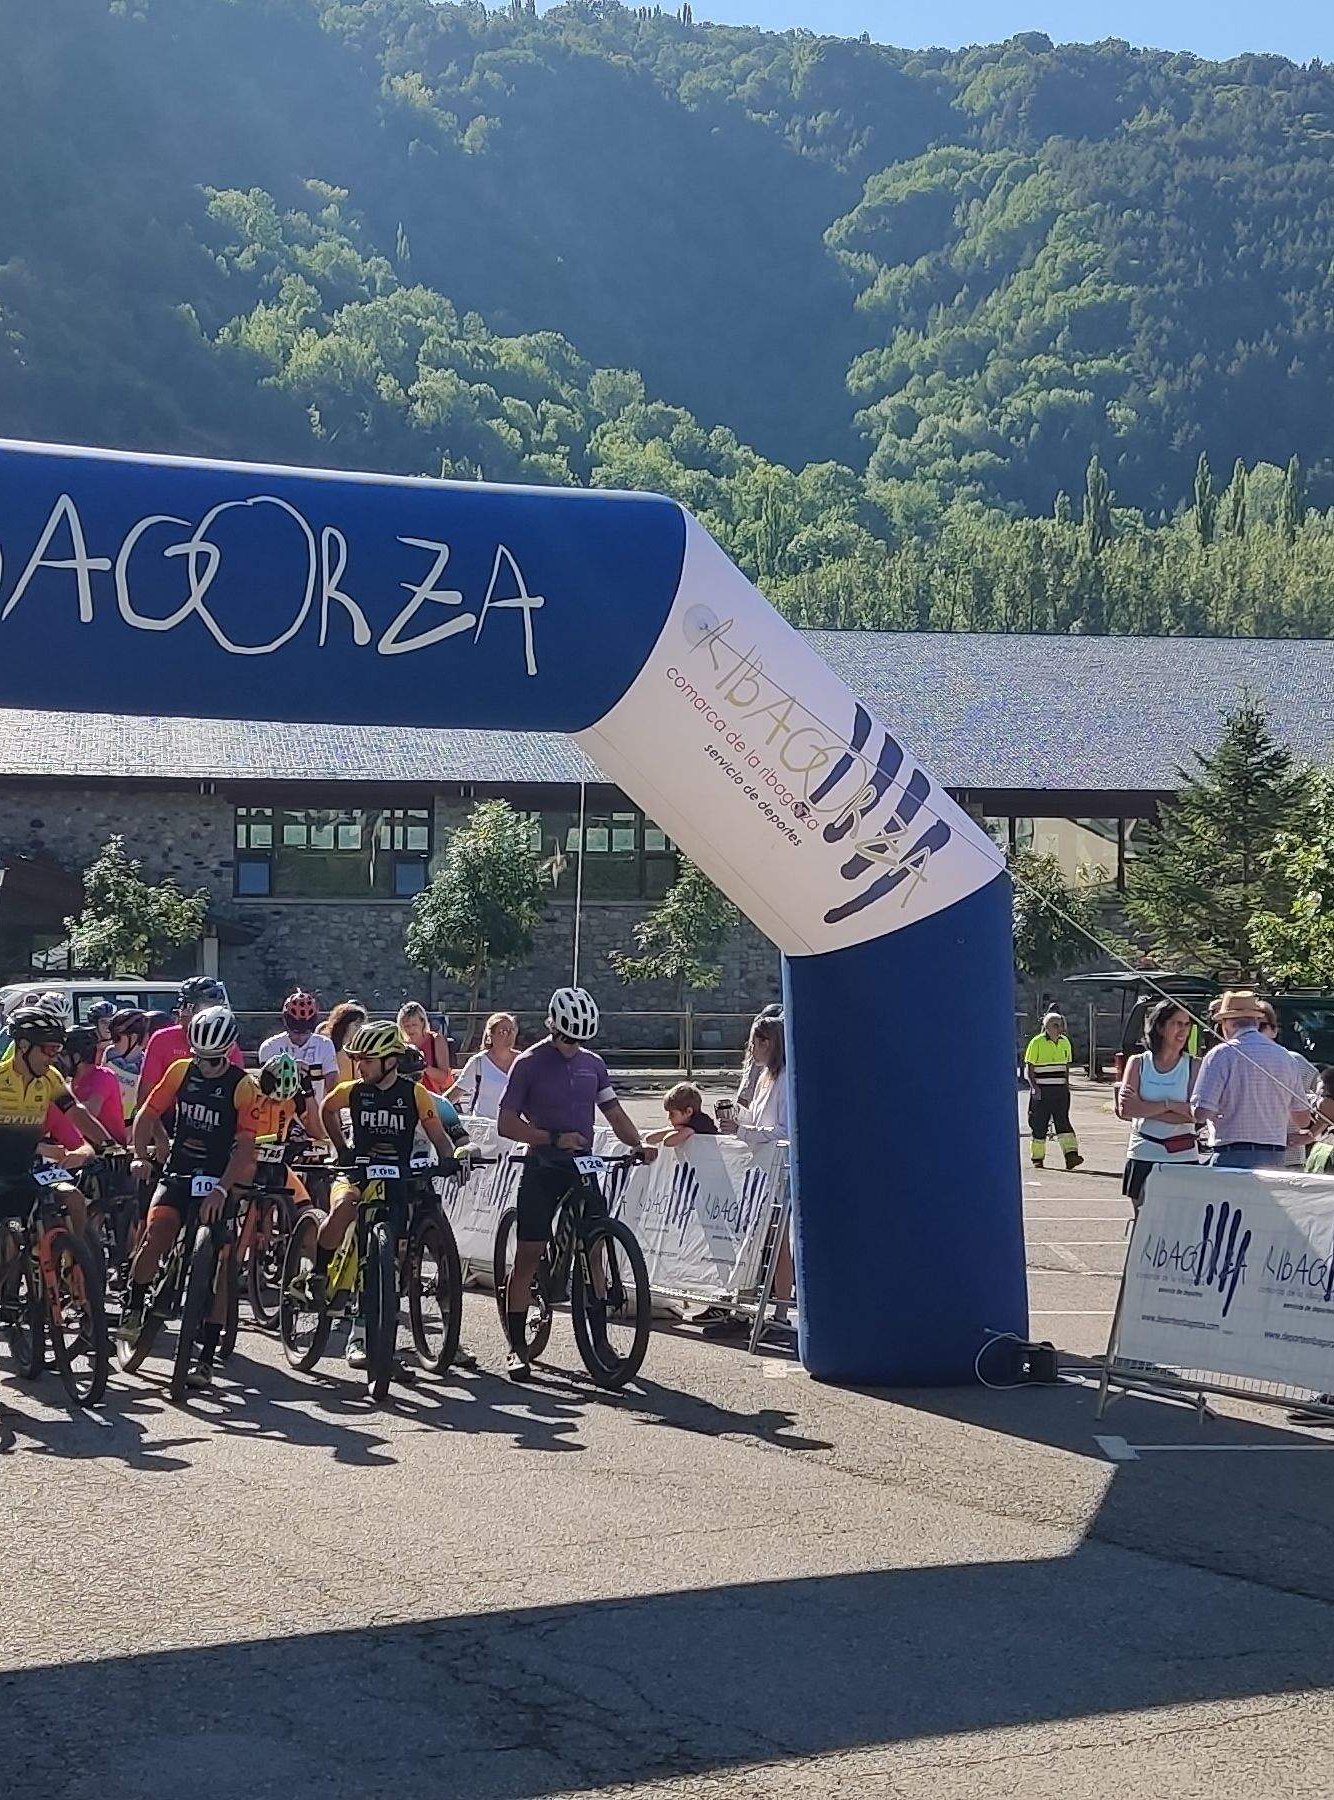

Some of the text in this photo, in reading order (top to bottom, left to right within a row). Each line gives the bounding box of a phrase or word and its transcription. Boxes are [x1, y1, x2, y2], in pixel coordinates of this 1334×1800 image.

[667, 667, 820, 831] comarca de la ribagorza
[704, 744, 803, 847] servicio de deportes
[181, 1101, 221, 1127] PEDAL
[360, 1109, 406, 1131] PEDAL
